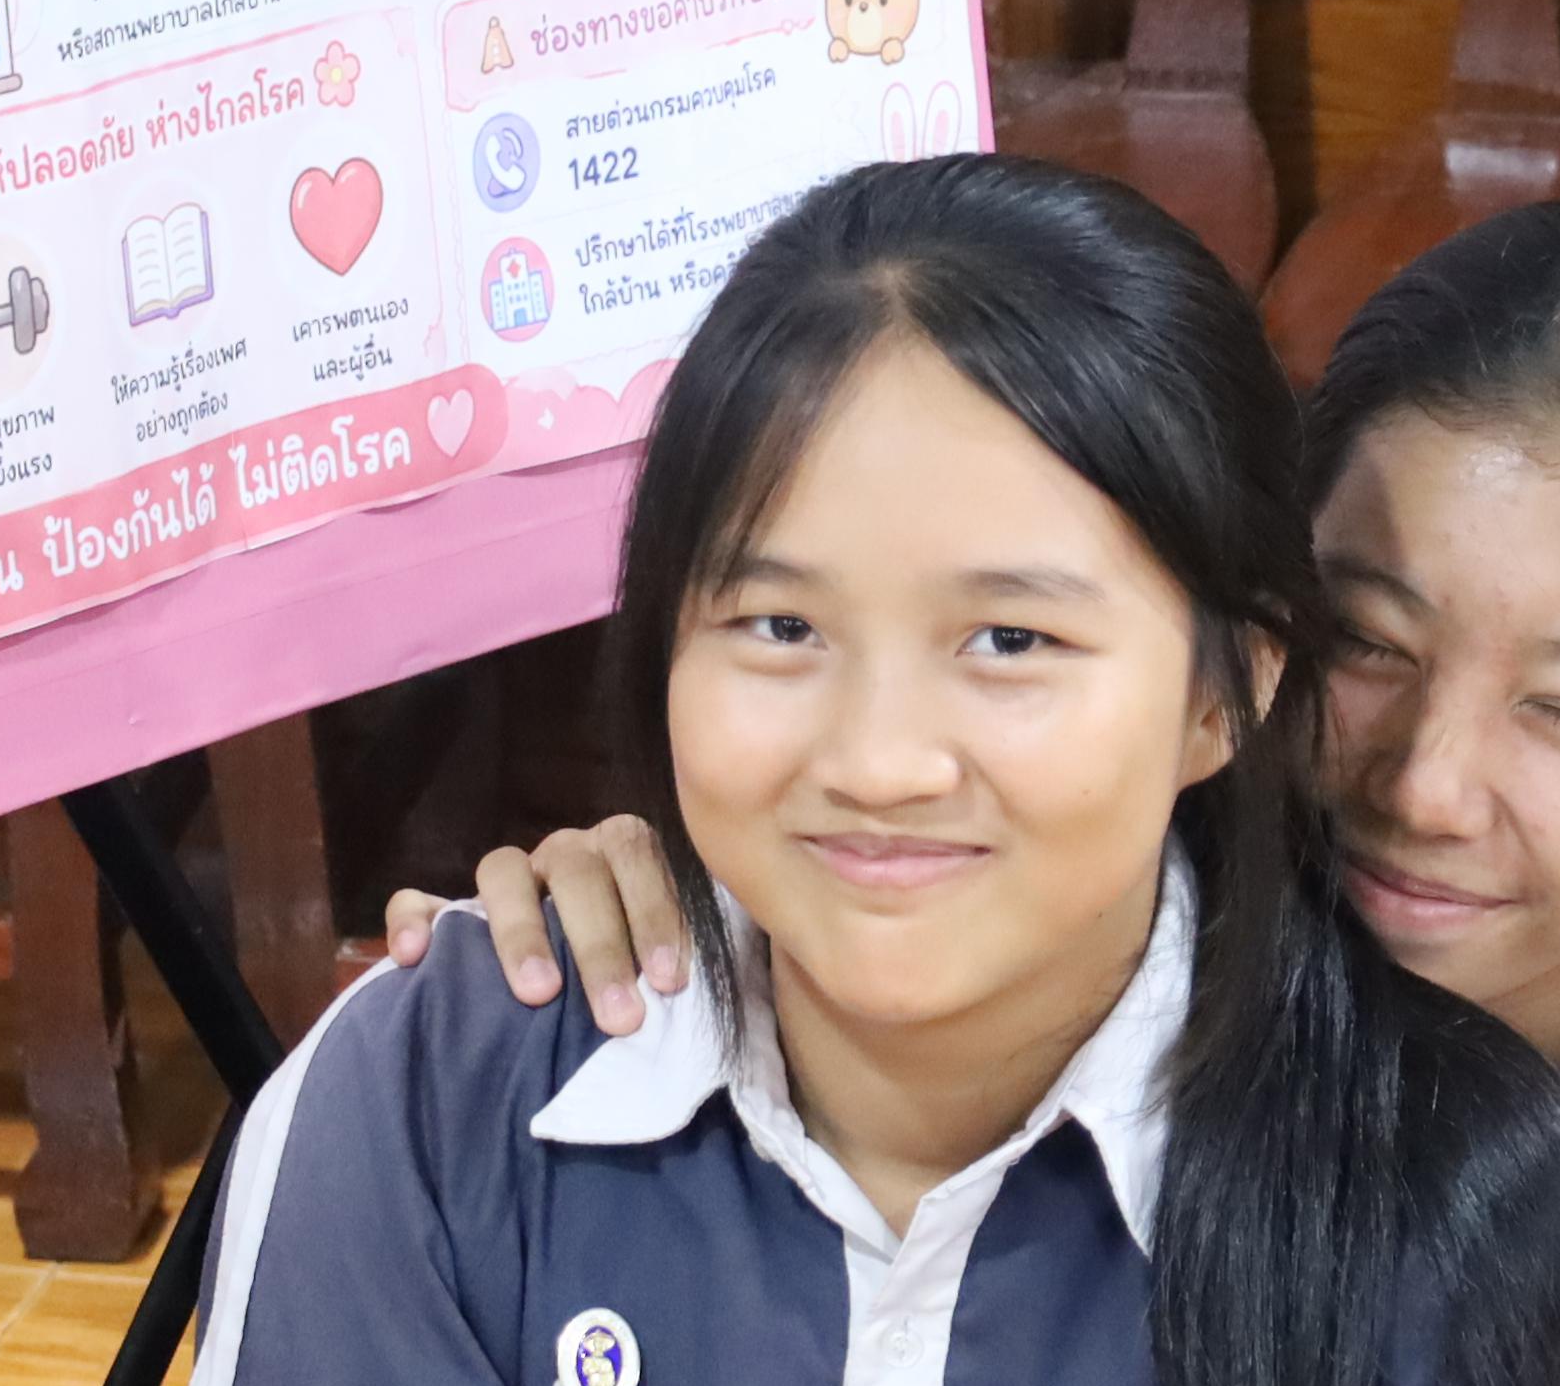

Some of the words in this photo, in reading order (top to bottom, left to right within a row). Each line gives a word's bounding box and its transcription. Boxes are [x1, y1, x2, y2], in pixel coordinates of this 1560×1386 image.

[146, 72, 306, 147] ห่างไกลโรค
[568, 146, 641, 192] 1422
[579, 270, 661, 317] ใกล้บ้าน
[230, 411, 412, 515] ไม่ติดโรค
